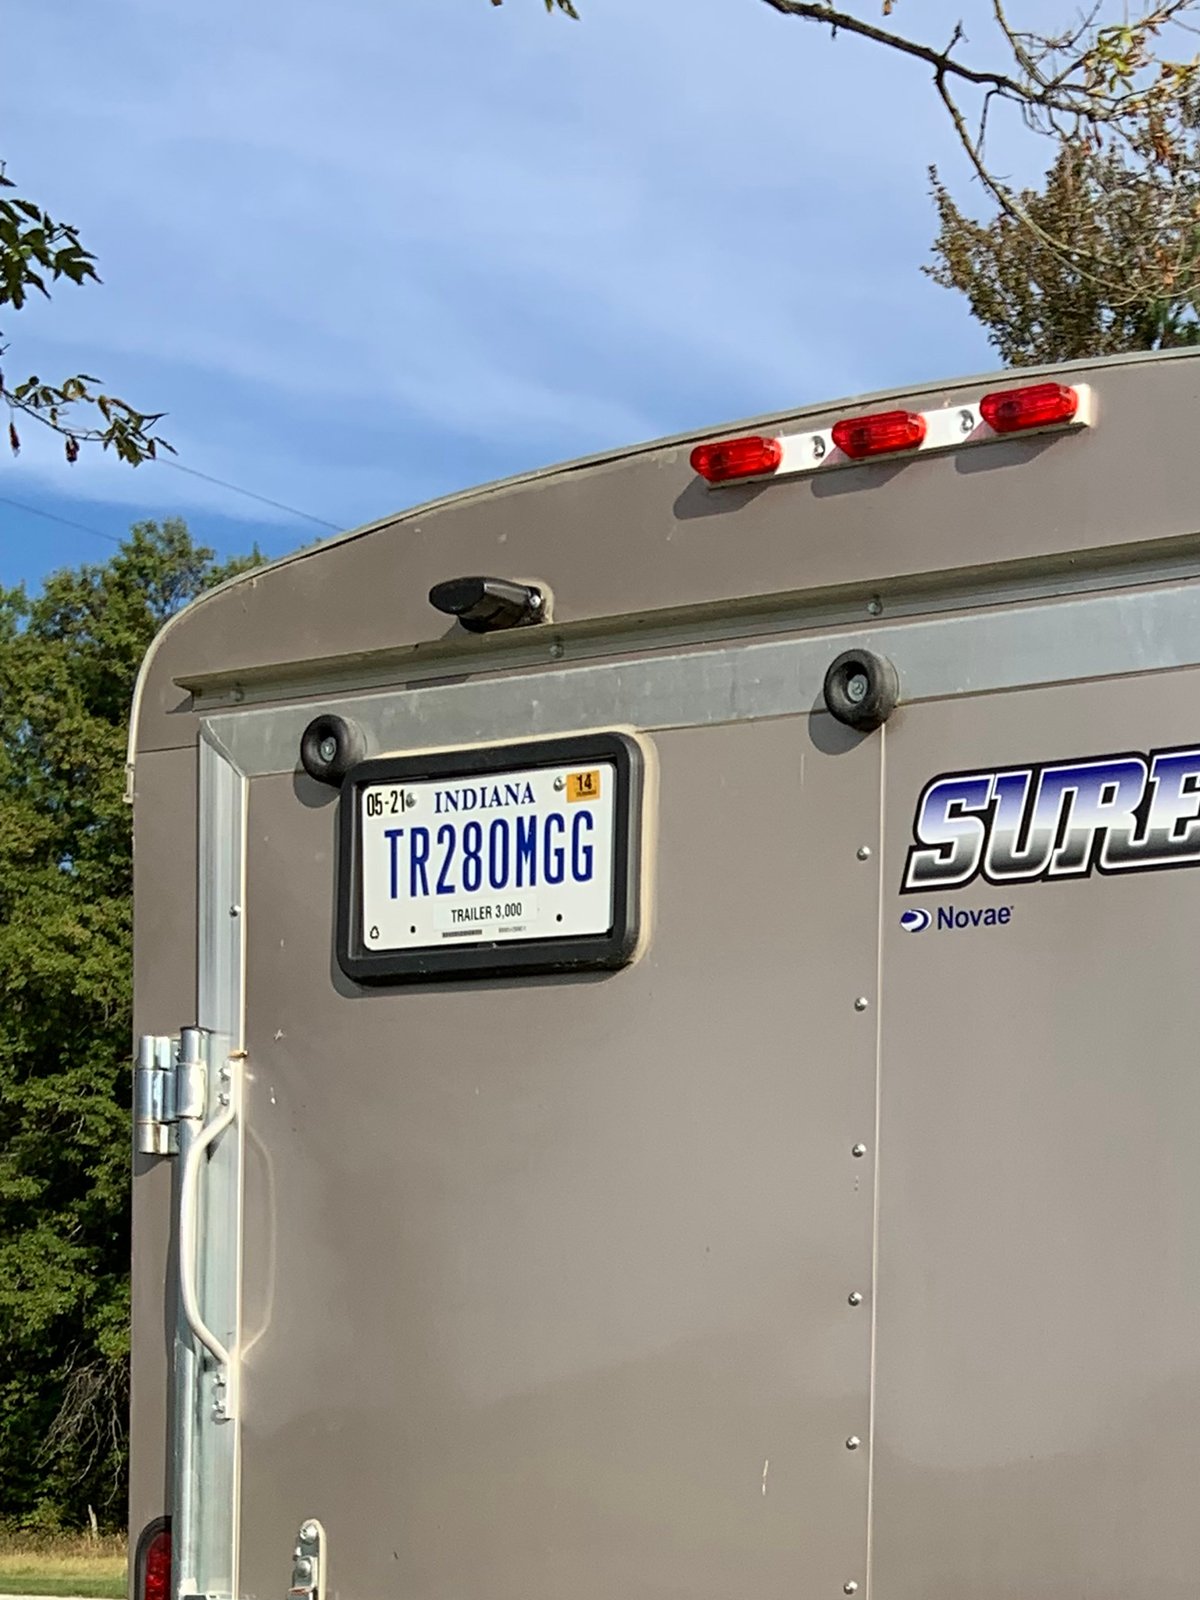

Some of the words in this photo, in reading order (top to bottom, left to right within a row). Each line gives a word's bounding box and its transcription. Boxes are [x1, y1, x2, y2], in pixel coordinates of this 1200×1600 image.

[576, 773, 592, 791] 14
[367, 789, 406, 817] 05-21
[434, 782, 536, 813] INDIANA
[384, 810, 594, 899] TR280MGG
[451, 905, 493, 923] TRAILER
[495, 902, 522, 919] 3,000
[937, 896, 1011, 930] Novae
